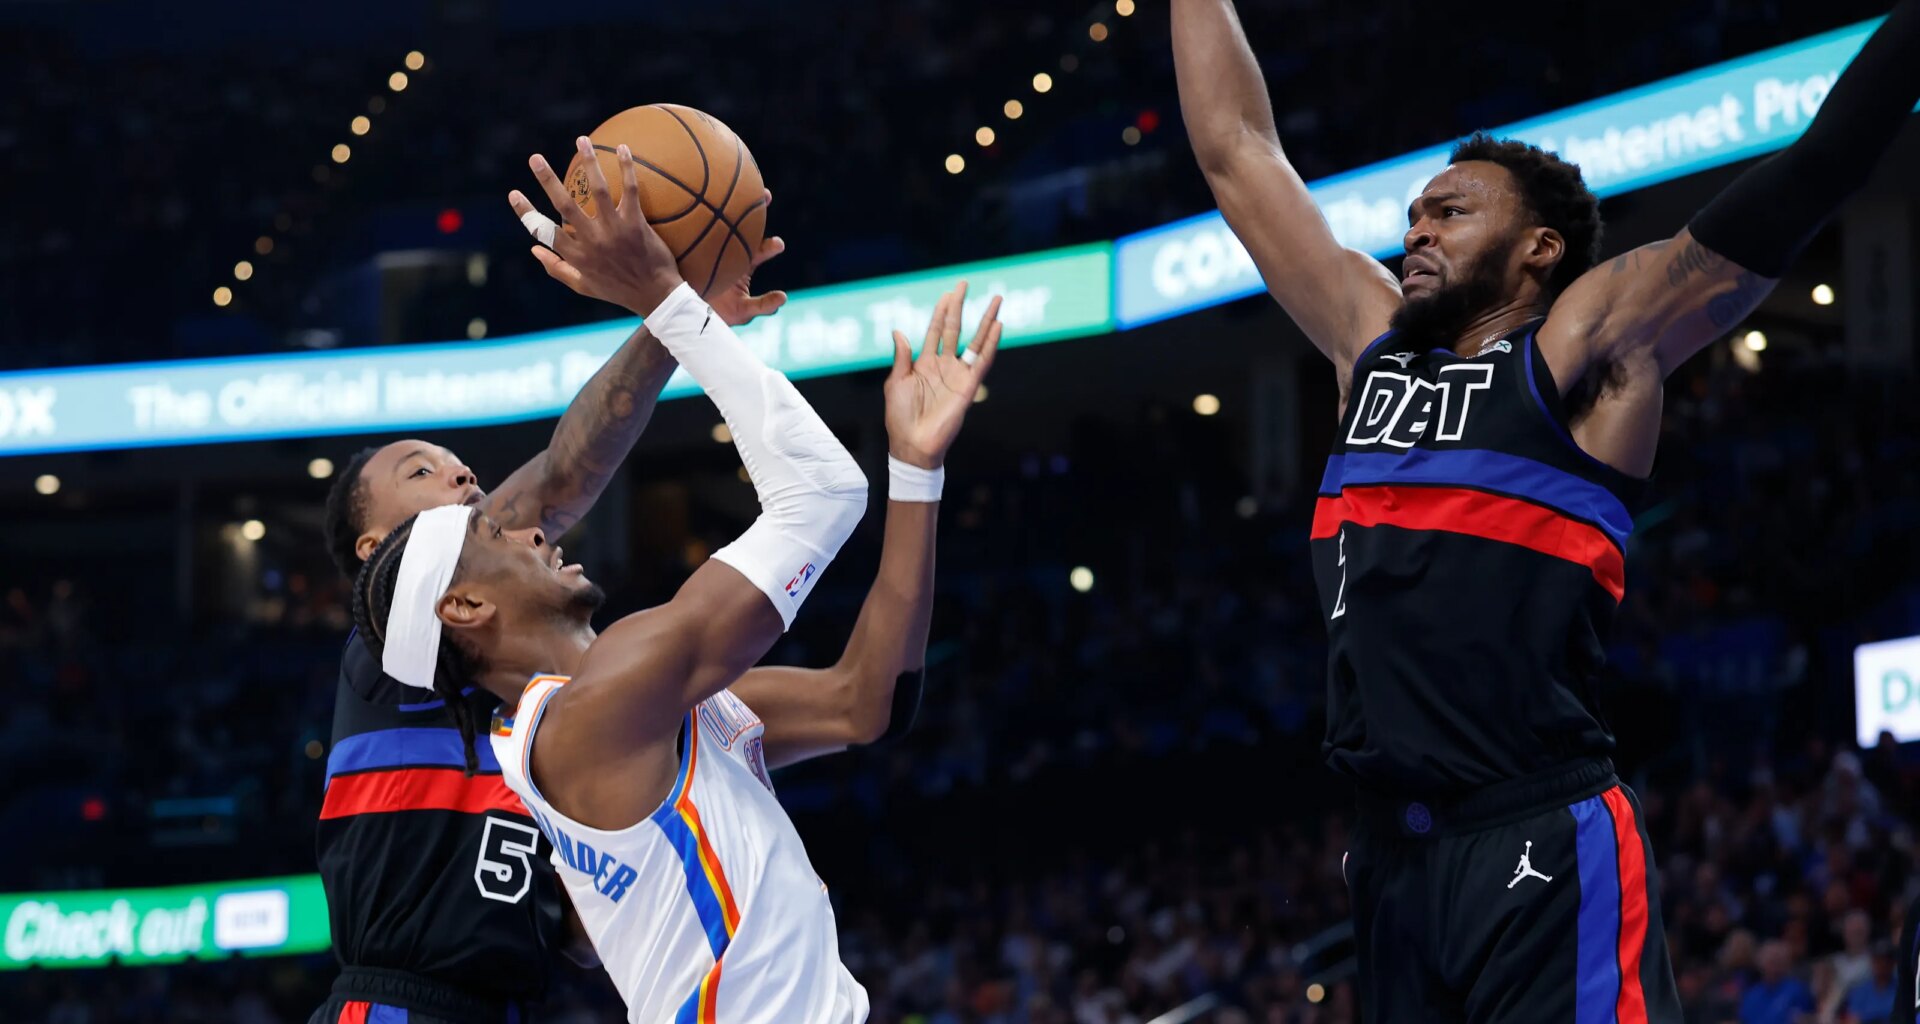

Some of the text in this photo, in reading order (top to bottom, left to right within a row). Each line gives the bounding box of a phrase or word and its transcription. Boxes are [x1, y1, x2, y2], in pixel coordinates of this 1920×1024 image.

[1753, 71, 1840, 135] Pro
[1346, 363, 1494, 448] DET
[474, 815, 540, 904] 5
